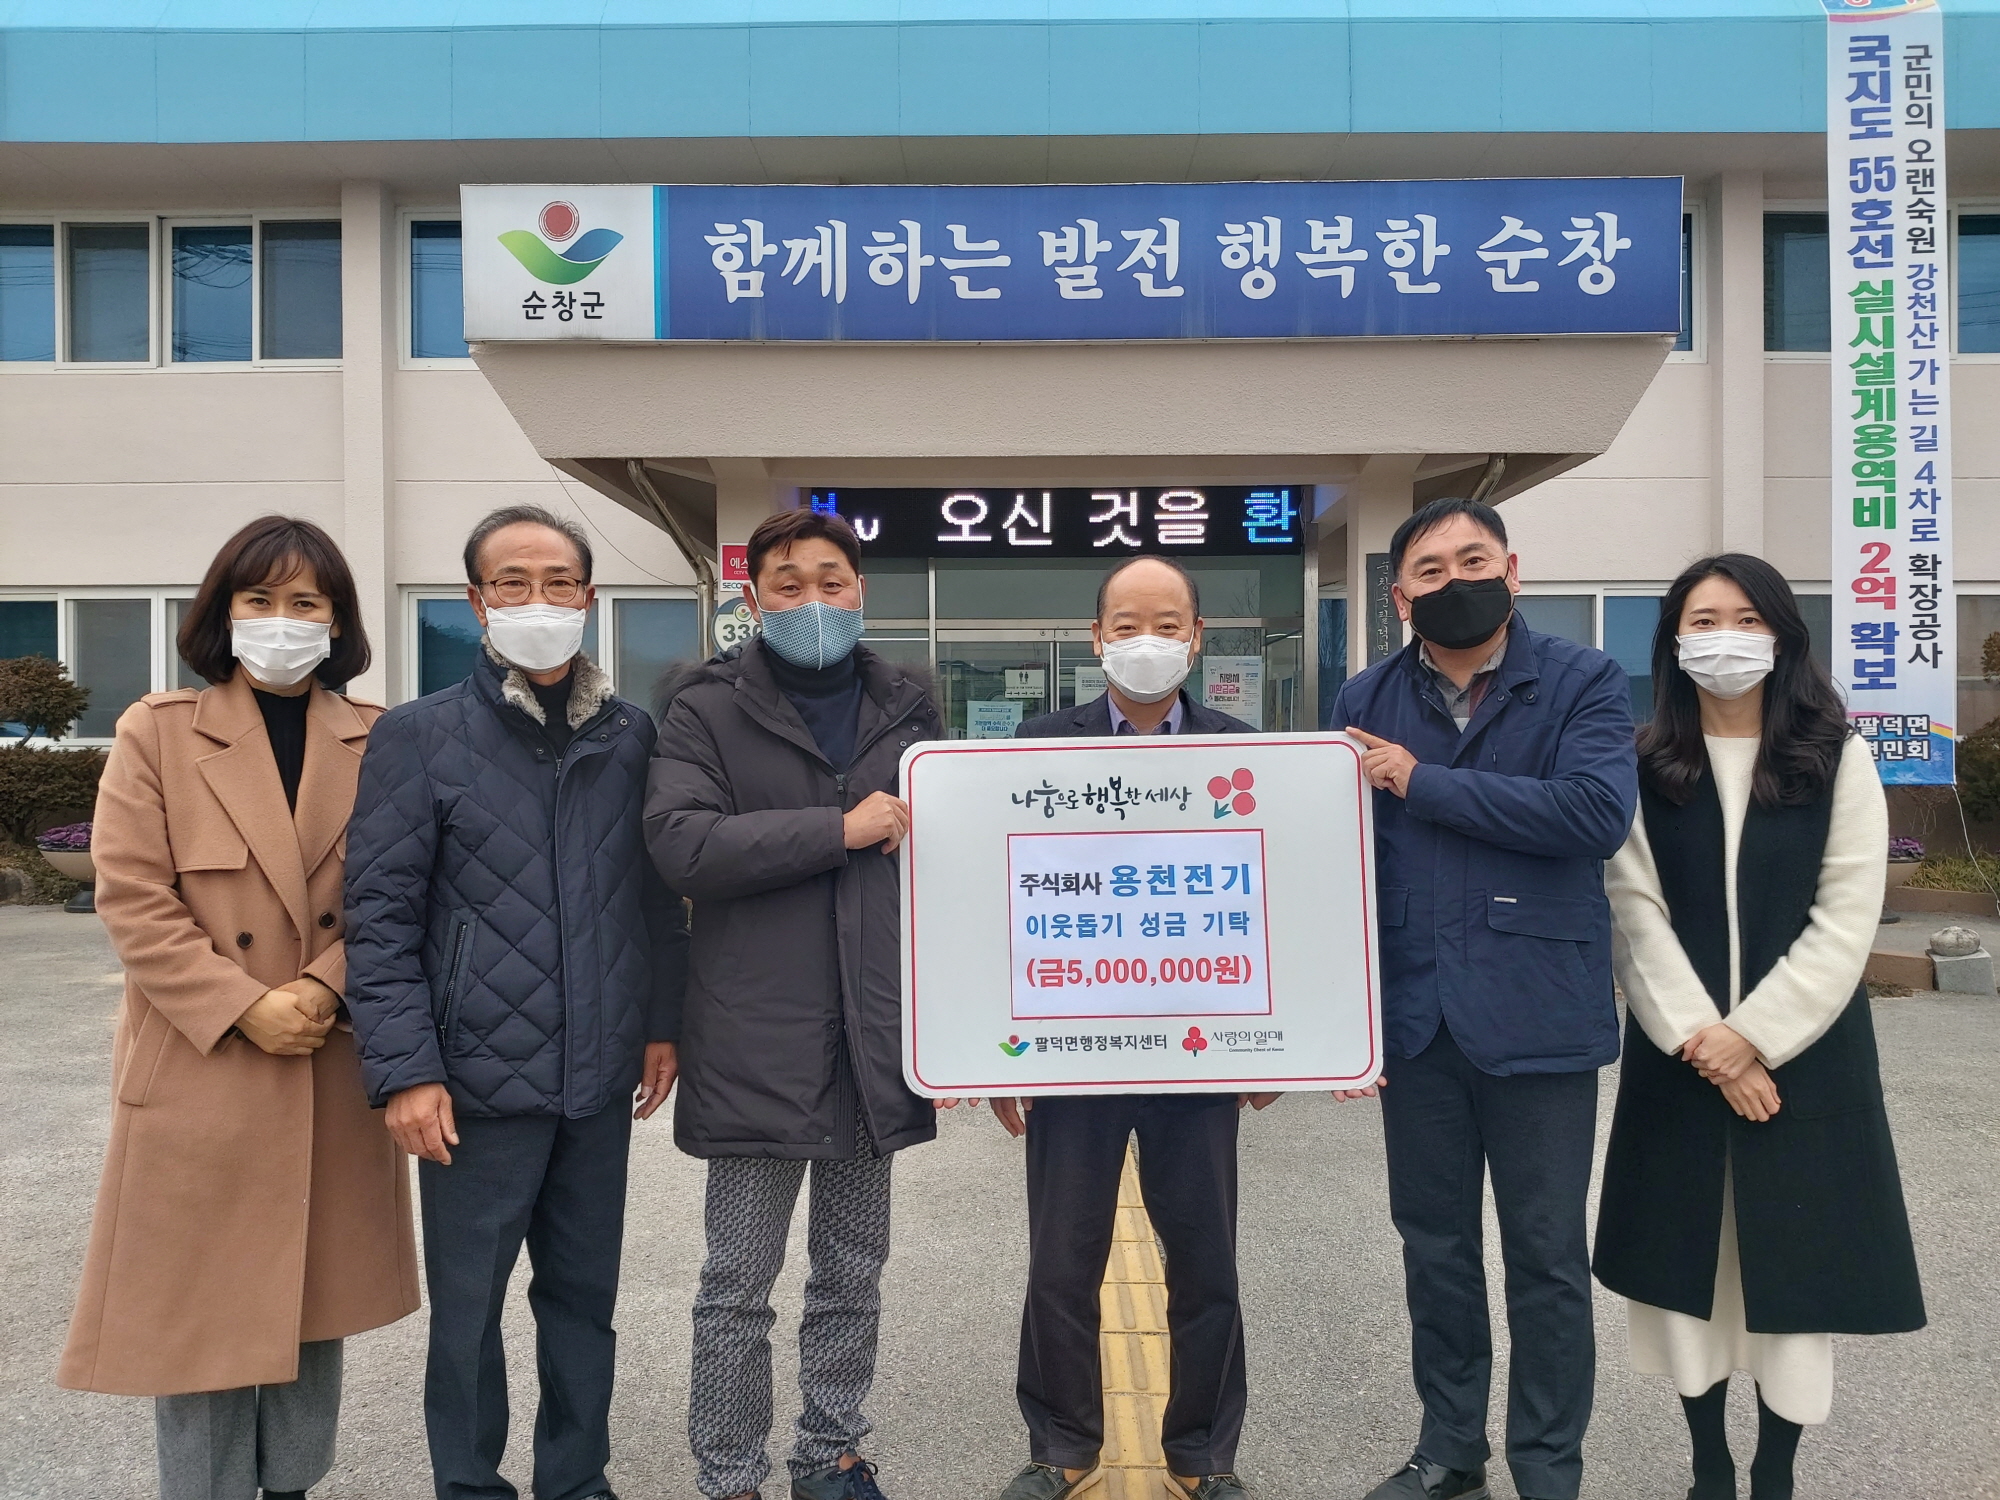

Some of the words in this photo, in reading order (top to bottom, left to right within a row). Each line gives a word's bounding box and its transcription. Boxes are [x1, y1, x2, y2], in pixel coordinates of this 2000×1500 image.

[1845, 35, 1893, 140] 국지도
[1903, 45, 1933, 129] 군민의
[704, 219, 1011, 304] 함께하는
[1038, 217, 1185, 299] 발전
[1216, 213, 1451, 299] 행복한
[1476, 211, 1632, 295] 순창
[521, 290, 605, 321] 순창군
[1906, 263, 1939, 349] 강천산
[1847, 280, 1897, 529] 실시설계용역비
[1908, 358, 1940, 416] 가는
[1909, 424, 1939, 452] 길
[937, 492, 1053, 546] 오신
[1089, 491, 1210, 547] 것을
[1851, 542, 1896, 610] 2억
[1908, 554, 1943, 669] 확장공사
[1851, 622, 1900, 690] 확보
[1857, 717, 1928, 735] 팔덕면
[1012, 779, 1079, 818] 나눔으로
[1081, 776, 1141, 820] 행복한
[1145, 786, 1192, 811] 세상
[1019, 872, 1102, 897] 주식회사
[1109, 863, 1250, 897] 용천전기
[1026, 912, 1122, 939] 이웃돕기
[1139, 912, 1187, 937] 성금
[1203, 911, 1250, 936] 기탁
[1027, 955, 1251, 987] (금5,000,000원)
[1034, 1034, 1167, 1053] 팔덕면행정복지센터
[1211, 1031, 1251, 1046] 사랑의
[1253, 1030, 1283, 1046] 열매
